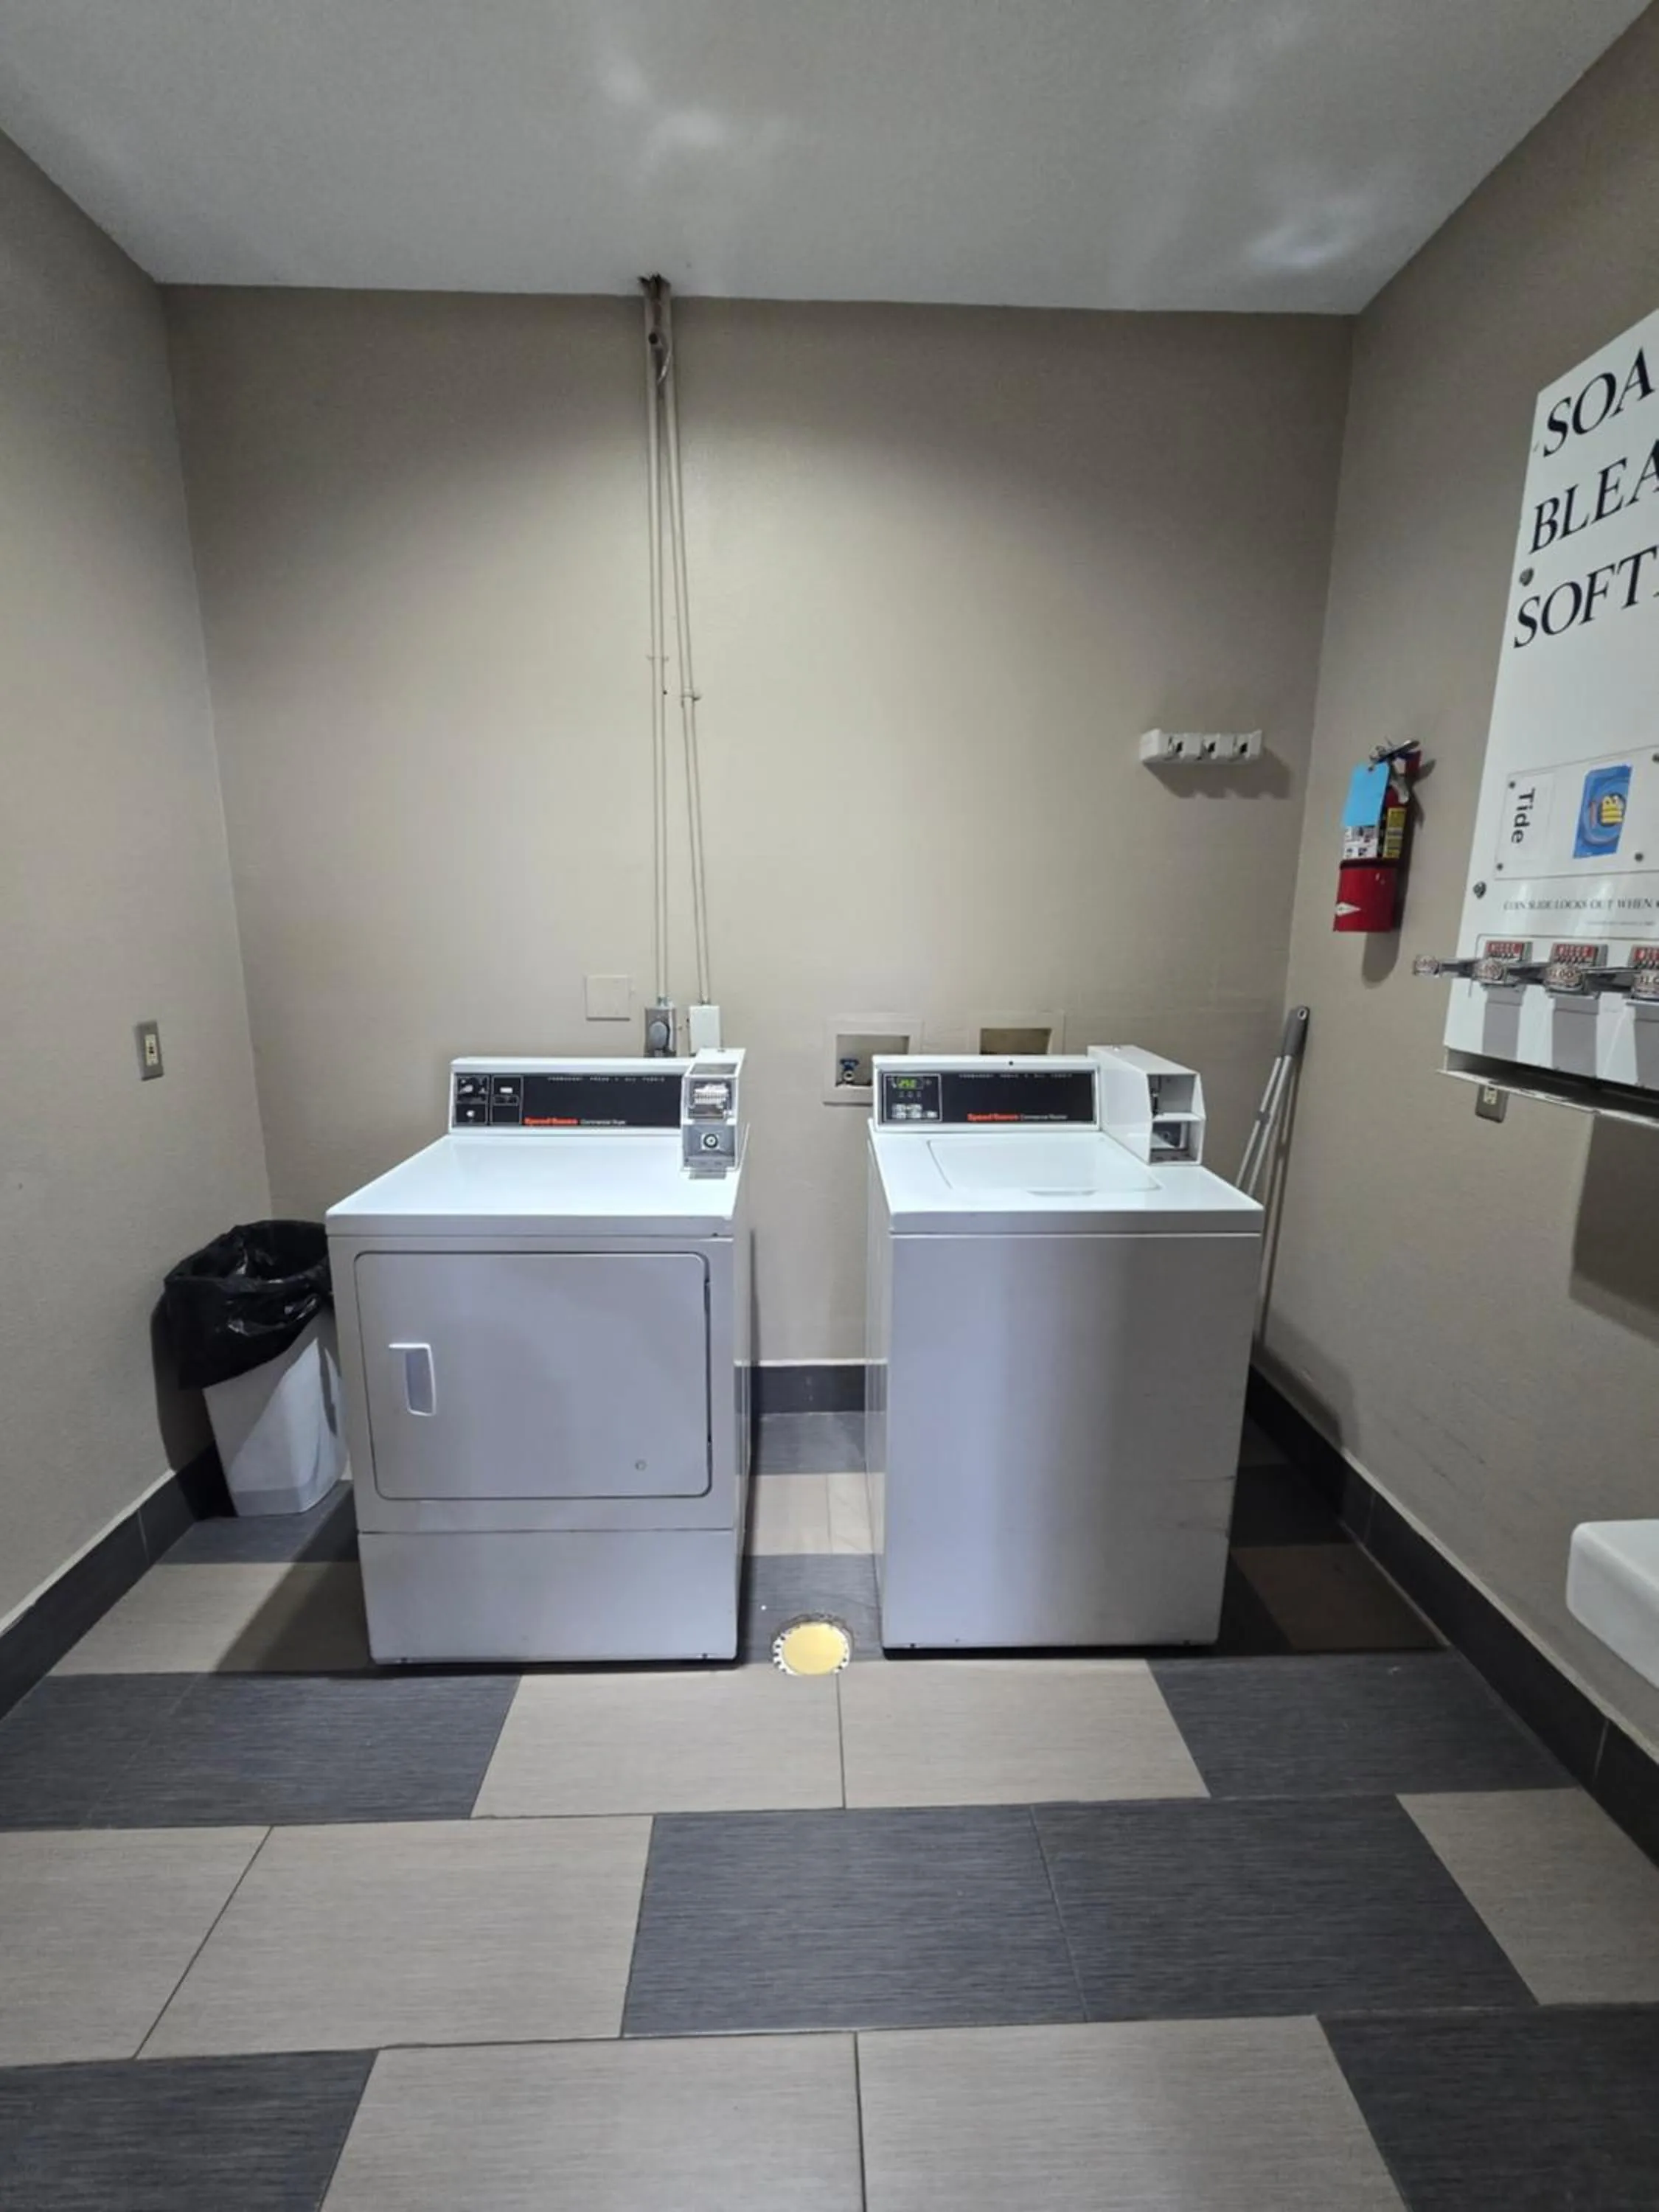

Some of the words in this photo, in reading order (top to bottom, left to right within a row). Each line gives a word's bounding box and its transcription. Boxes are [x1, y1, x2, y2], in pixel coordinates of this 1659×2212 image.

[1514, 545, 1659, 649] SOFT
[1511, 787, 1535, 844] Tide
[1617, 898, 1652, 909] WHEN
